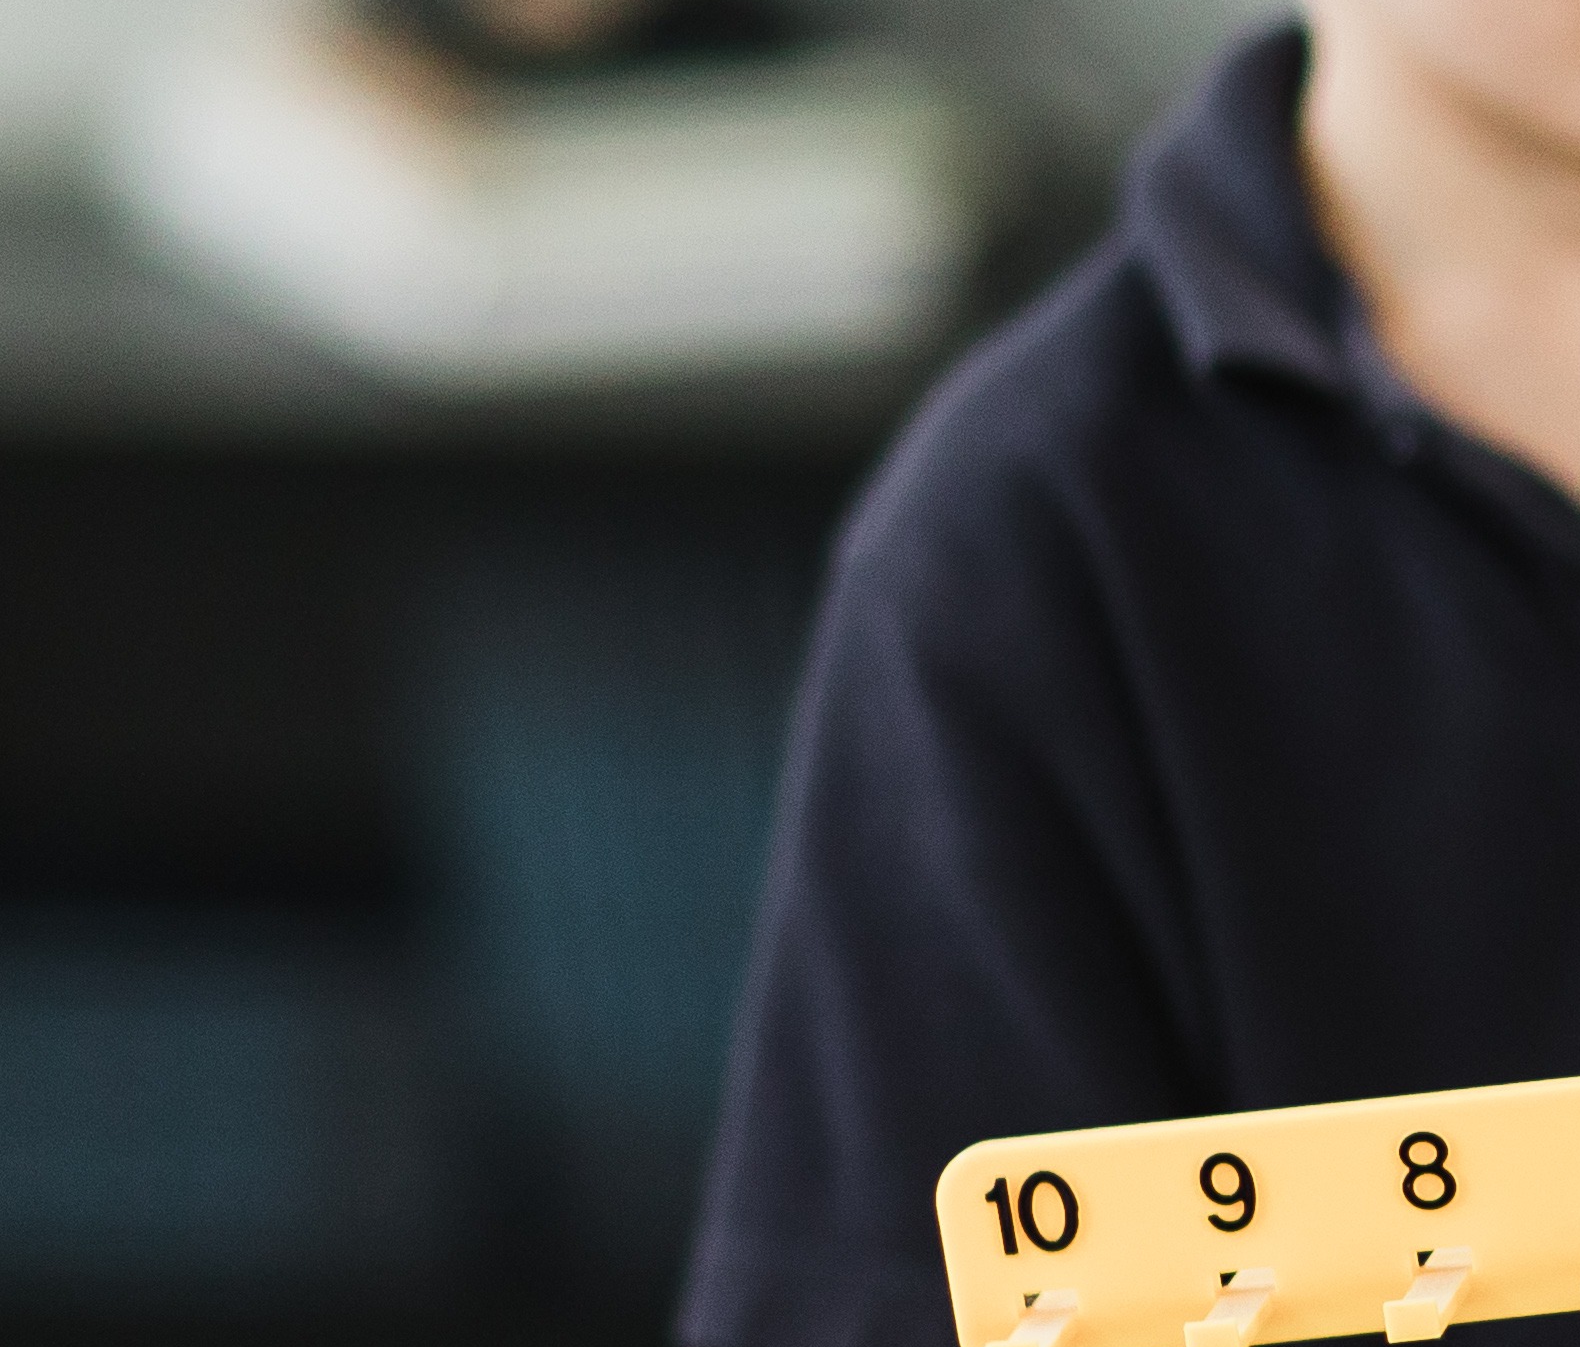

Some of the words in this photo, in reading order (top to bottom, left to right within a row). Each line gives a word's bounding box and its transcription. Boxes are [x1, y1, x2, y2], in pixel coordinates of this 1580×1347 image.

[983, 1169, 1080, 1257] 10
[1198, 1151, 1258, 1234] 9
[1397, 1130, 1458, 1212] 8
